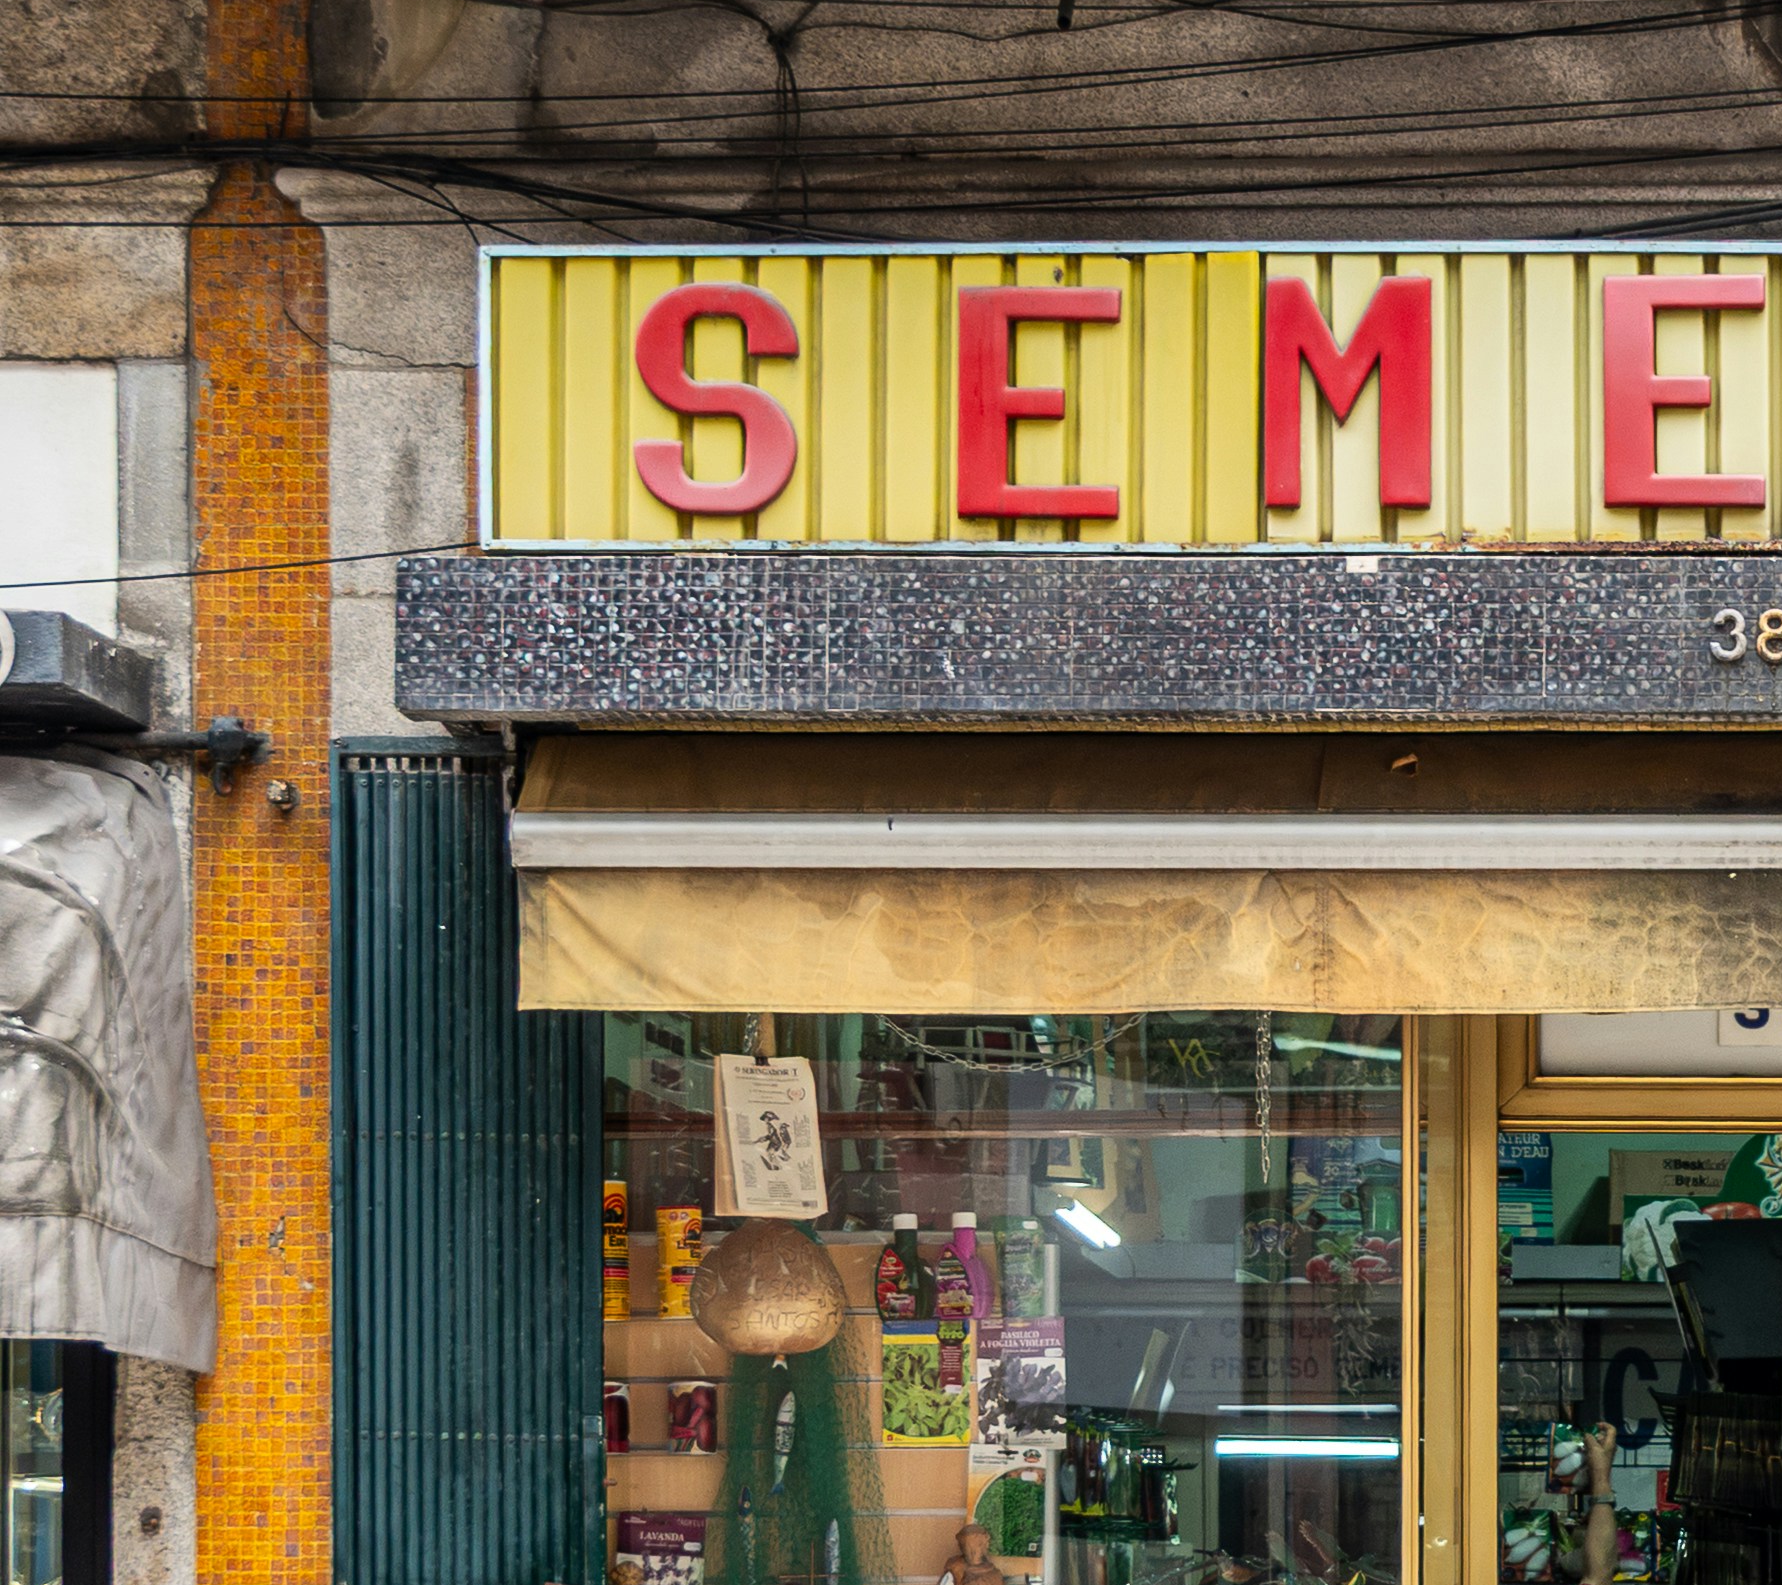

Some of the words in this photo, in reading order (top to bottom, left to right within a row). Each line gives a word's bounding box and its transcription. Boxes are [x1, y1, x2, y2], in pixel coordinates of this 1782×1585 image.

[1001, 1330, 1040, 1339] BASILICO
[988, 1339, 1019, 1348] FOGLIA
[1020, 1338, 1062, 1347] VIOLETTA
[639, 1530, 685, 1542] LAVANDA
